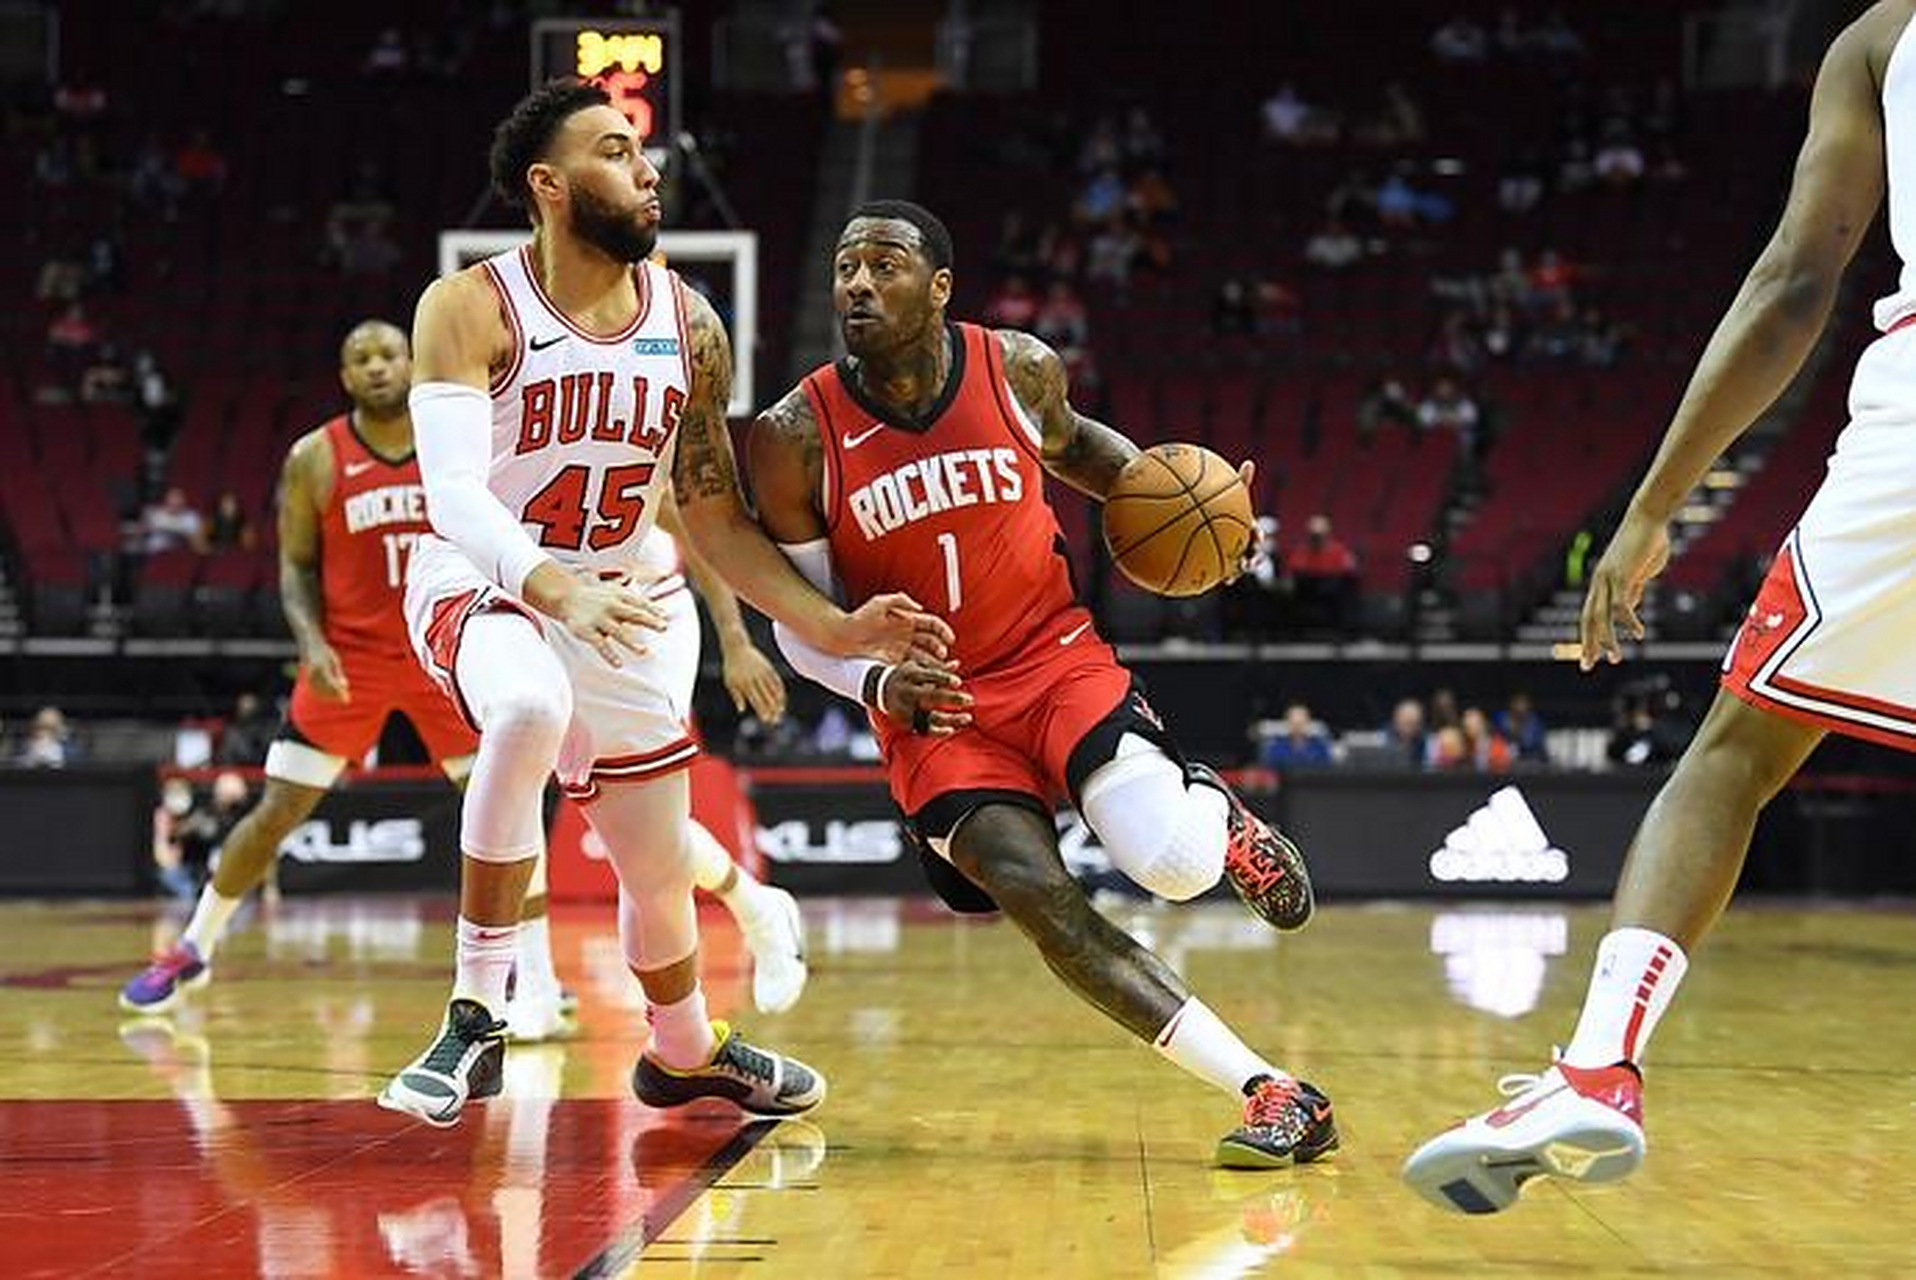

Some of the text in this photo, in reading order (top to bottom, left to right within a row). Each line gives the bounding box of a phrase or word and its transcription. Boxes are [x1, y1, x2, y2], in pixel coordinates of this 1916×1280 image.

[515, 371, 685, 459] BULLS
[345, 484, 425, 534] ROCKE
[521, 463, 656, 552] 45
[849, 448, 1023, 541] ROCKETS
[938, 532, 961, 612] 1
[755, 820, 901, 863] XUS
